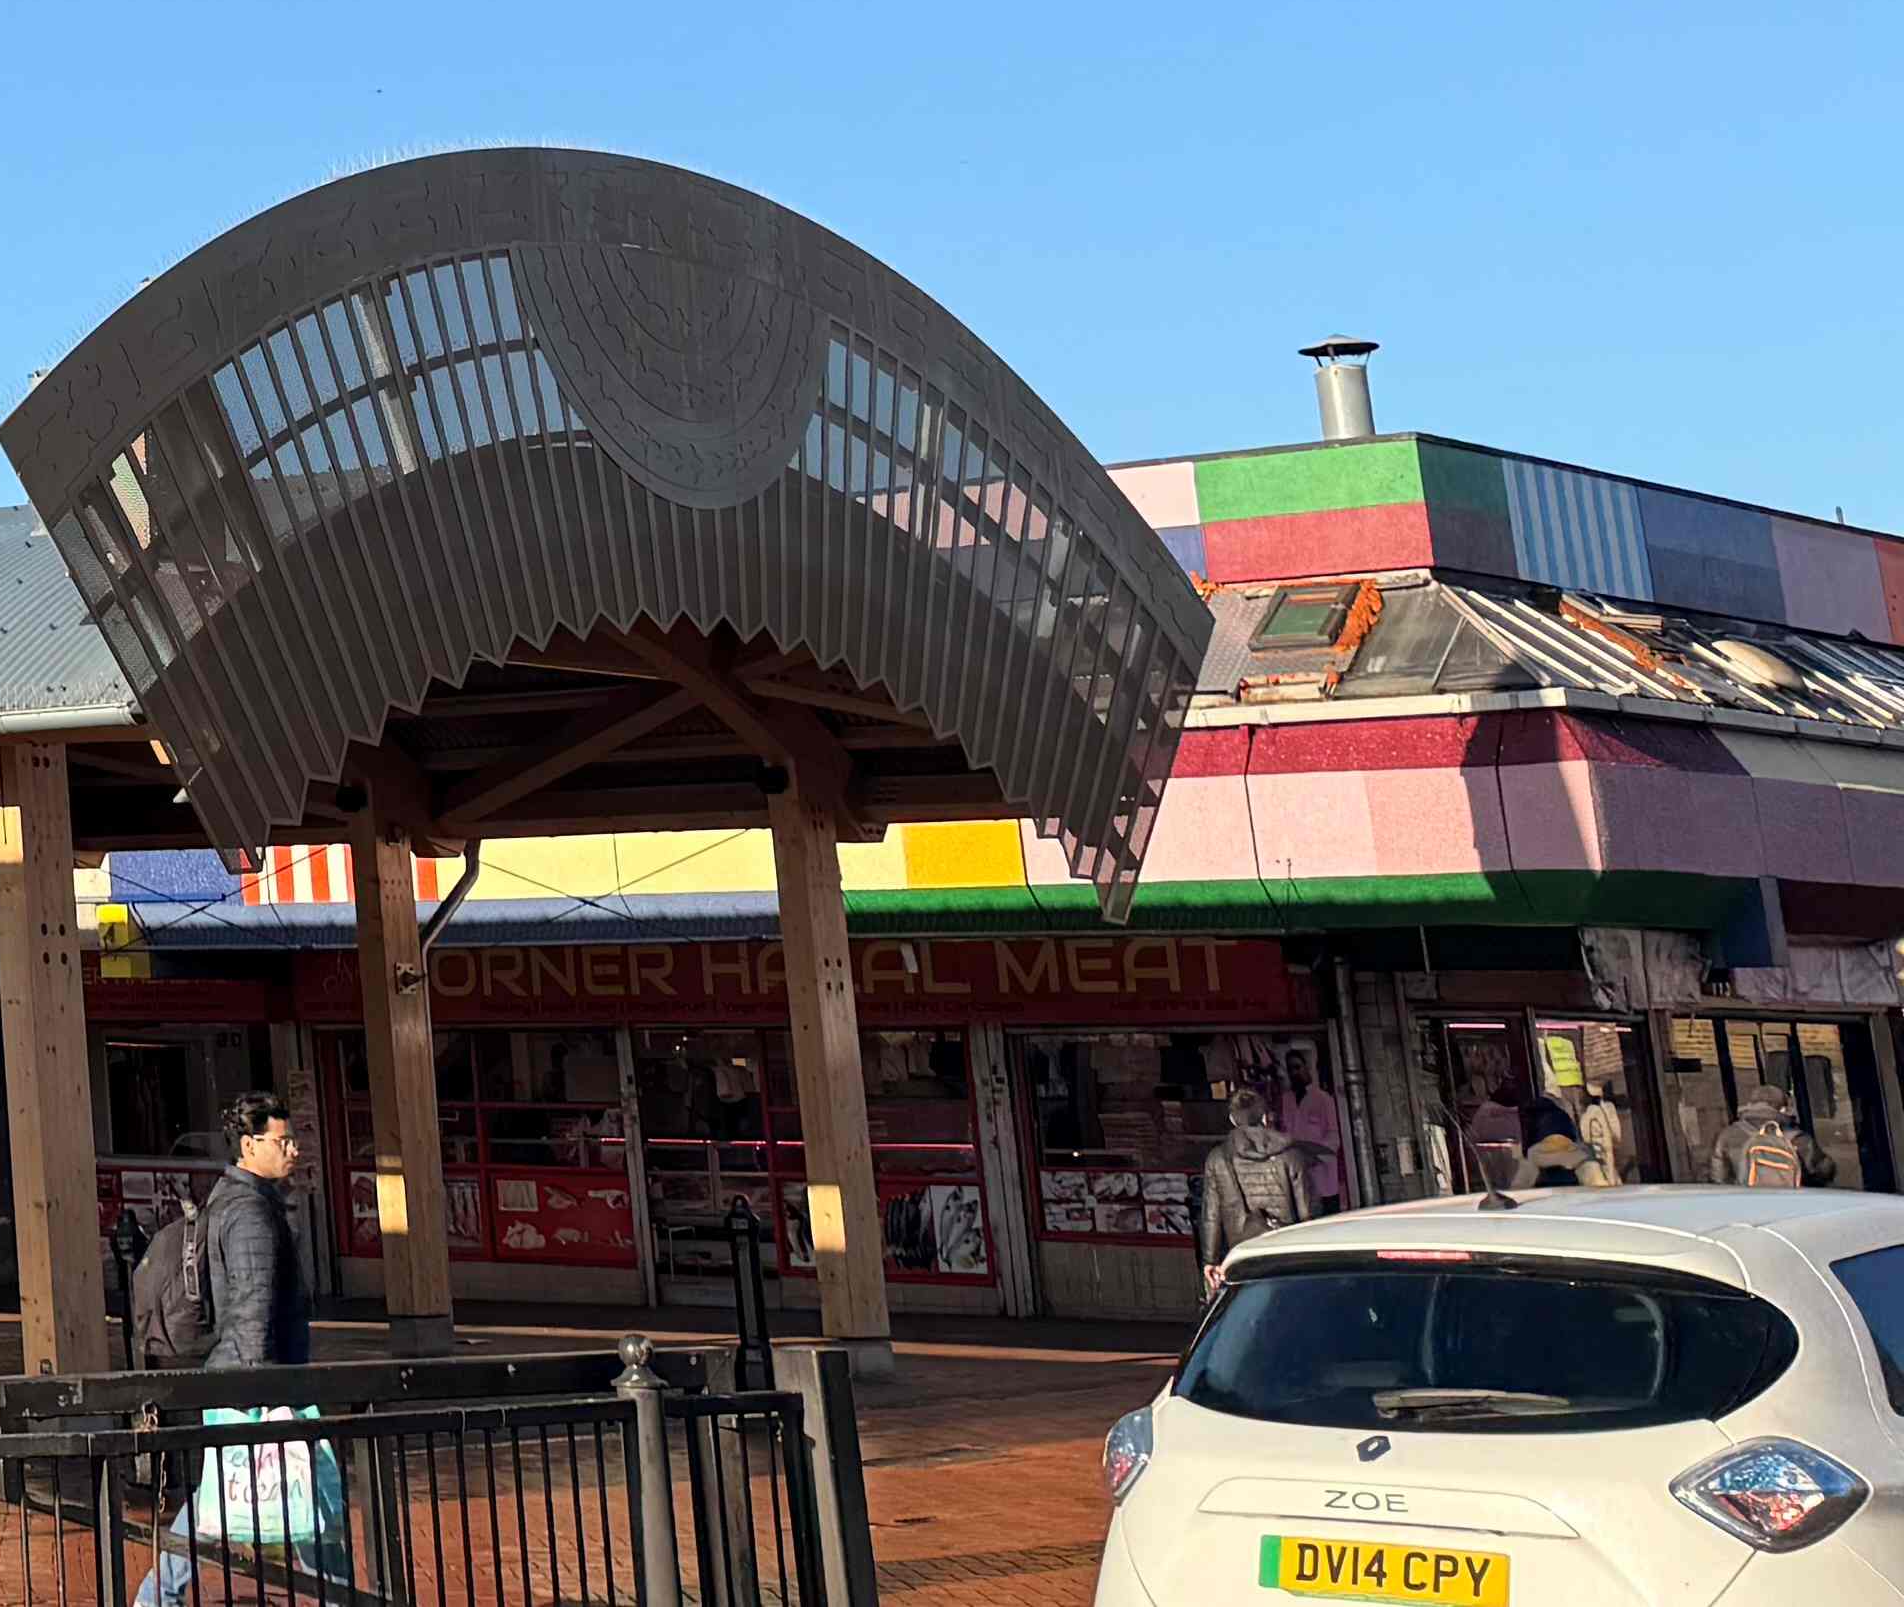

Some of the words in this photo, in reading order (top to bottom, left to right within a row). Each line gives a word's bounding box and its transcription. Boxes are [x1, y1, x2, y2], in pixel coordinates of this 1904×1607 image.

[430, 943, 676, 996] ORNER
[995, 936, 1238, 994] MEAT
[1324, 1490, 1409, 1512] ZOE
[1295, 1543, 1388, 1588] DV14
[1403, 1552, 1491, 1597] CPY
